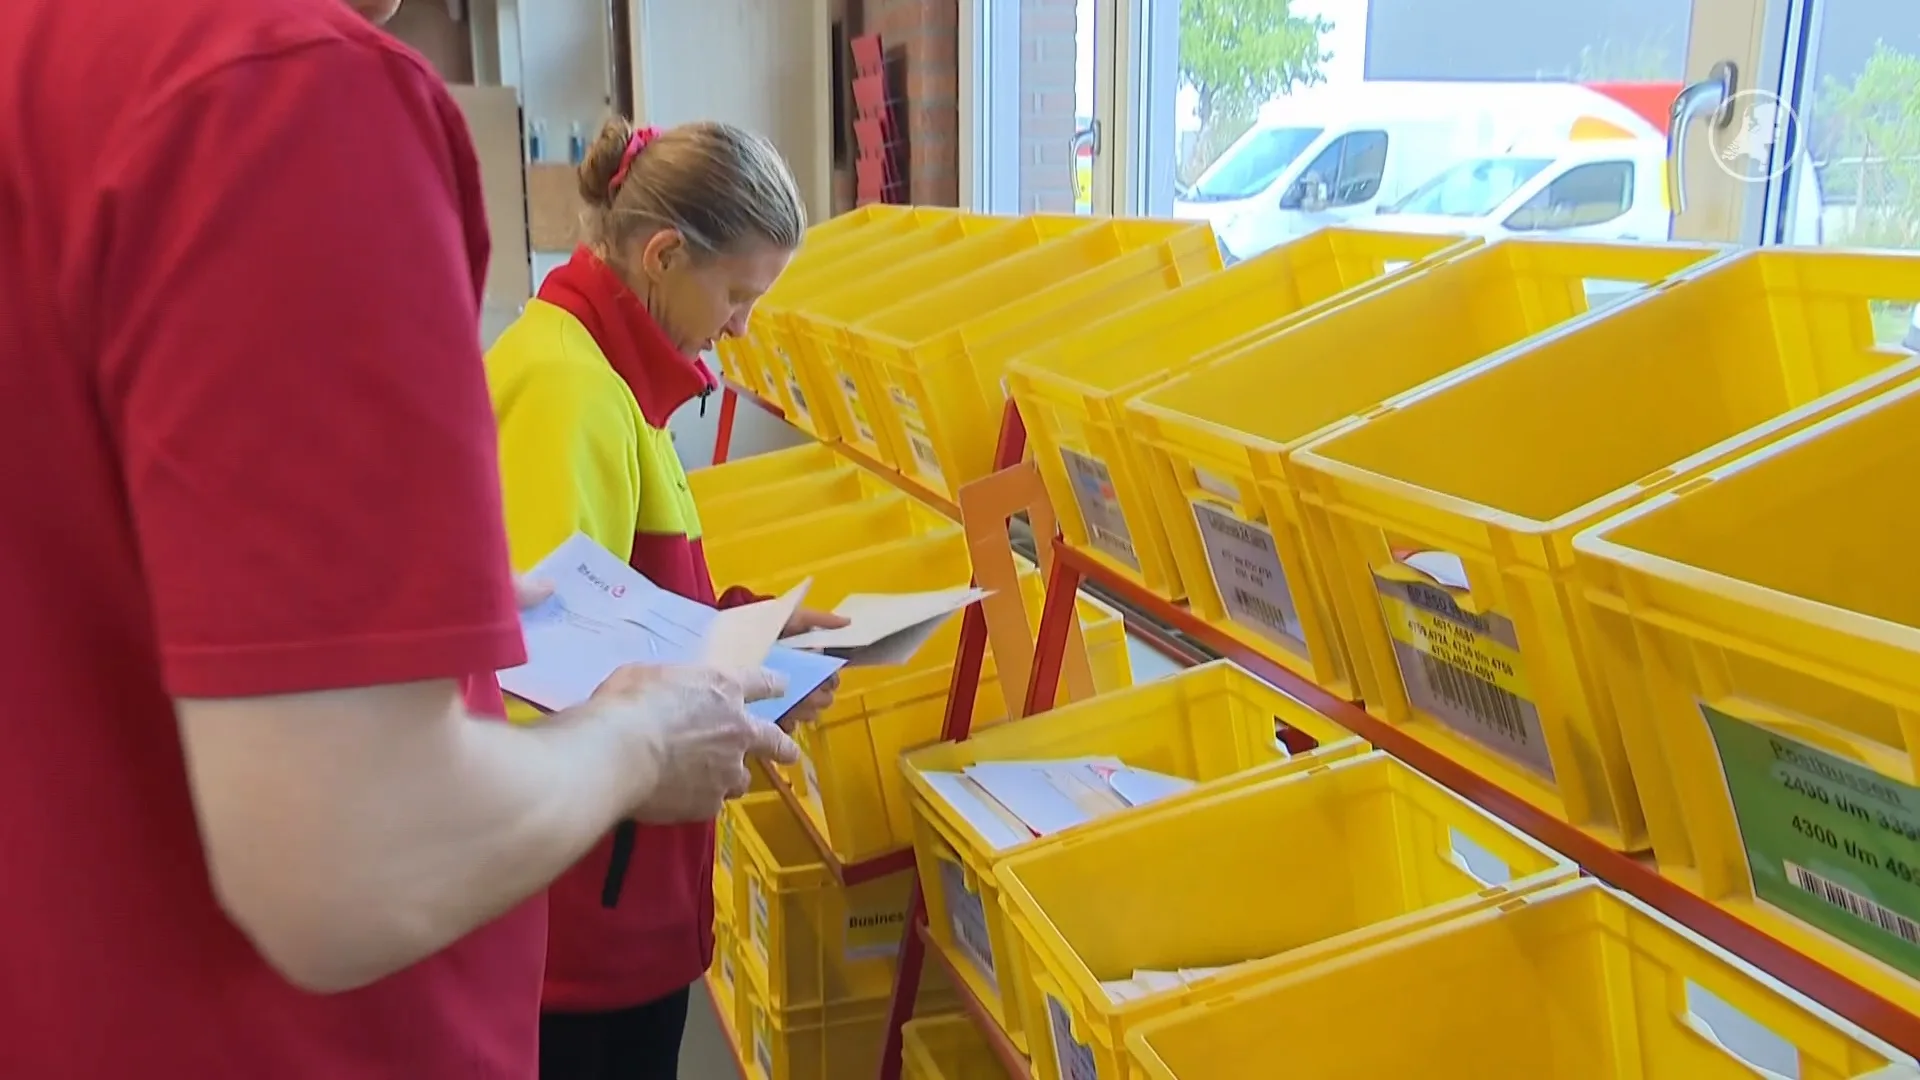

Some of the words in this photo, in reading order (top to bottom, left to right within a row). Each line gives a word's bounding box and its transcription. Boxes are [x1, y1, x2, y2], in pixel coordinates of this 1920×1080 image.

[1769, 738, 1902, 804] Postbussen
[1780, 770, 1829, 805] 2490
[1835, 792, 1871, 824] t/m
[1791, 815, 1838, 850] 4300
[1844, 837, 1879, 868] t/m
